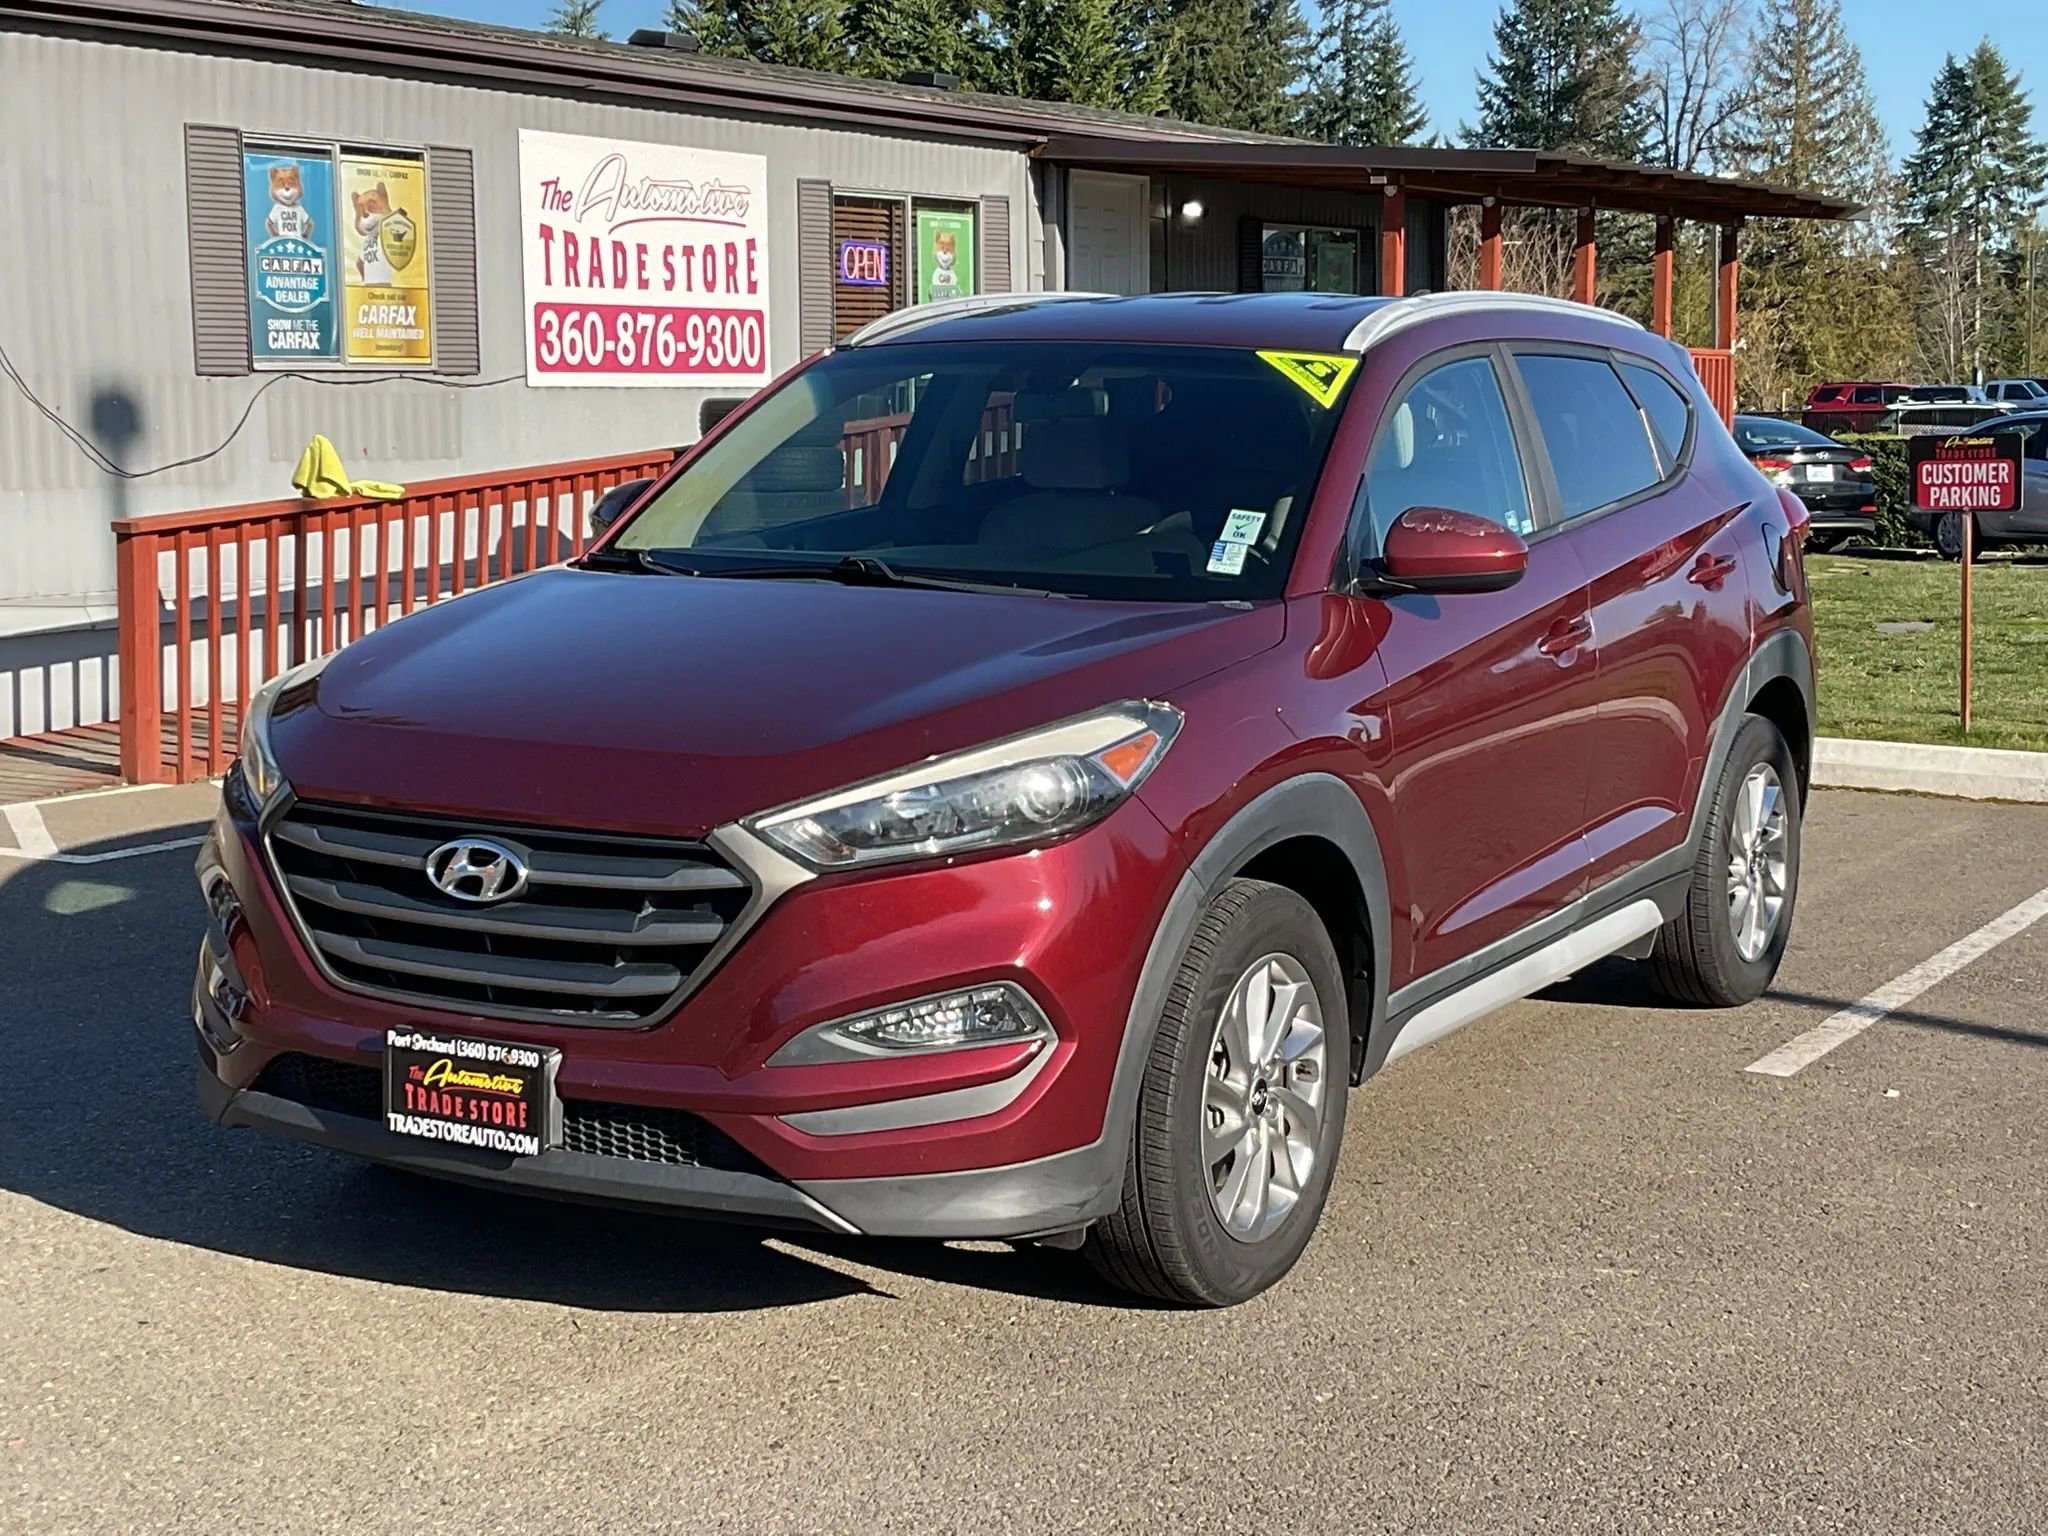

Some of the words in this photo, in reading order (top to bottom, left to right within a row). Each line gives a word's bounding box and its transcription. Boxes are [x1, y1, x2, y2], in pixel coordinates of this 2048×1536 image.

[540, 176, 574, 212] The
[574, 153, 753, 223] Automotive
[280, 211, 298, 221] CAR
[282, 223, 298, 232] FOX
[261, 258, 321, 274] CARFAX
[539, 222, 650, 290] TRADE
[662, 237, 758, 294] STORE
[844, 246, 886, 284] OPEN
[265, 276, 319, 290] ADVANTAGE
[275, 290, 311, 304] DEALER
[267, 319, 292, 331] SHOW
[305, 320, 320, 331] THE
[358, 304, 417, 326] CARFAX
[268, 331, 321, 349] CARFAX
[539, 309, 761, 368] 360-876-9300
[1922, 462, 2009, 485] CUSTOMER
[1930, 486, 2001, 507] PARKING
[1231, 513, 1262, 522] SAFETY
[1232, 531, 1247, 539] OK
[387, 1030, 411, 1047] Port
[456, 1040, 486, 1060] (360)
[409, 1065, 425, 1081] The
[423, 1058, 525, 1094] Automotive
[405, 1083, 465, 1118] TRADE
[469, 1099, 528, 1128] STORE
[387, 1112, 539, 1156] TRADESTOREAUTO.COM
